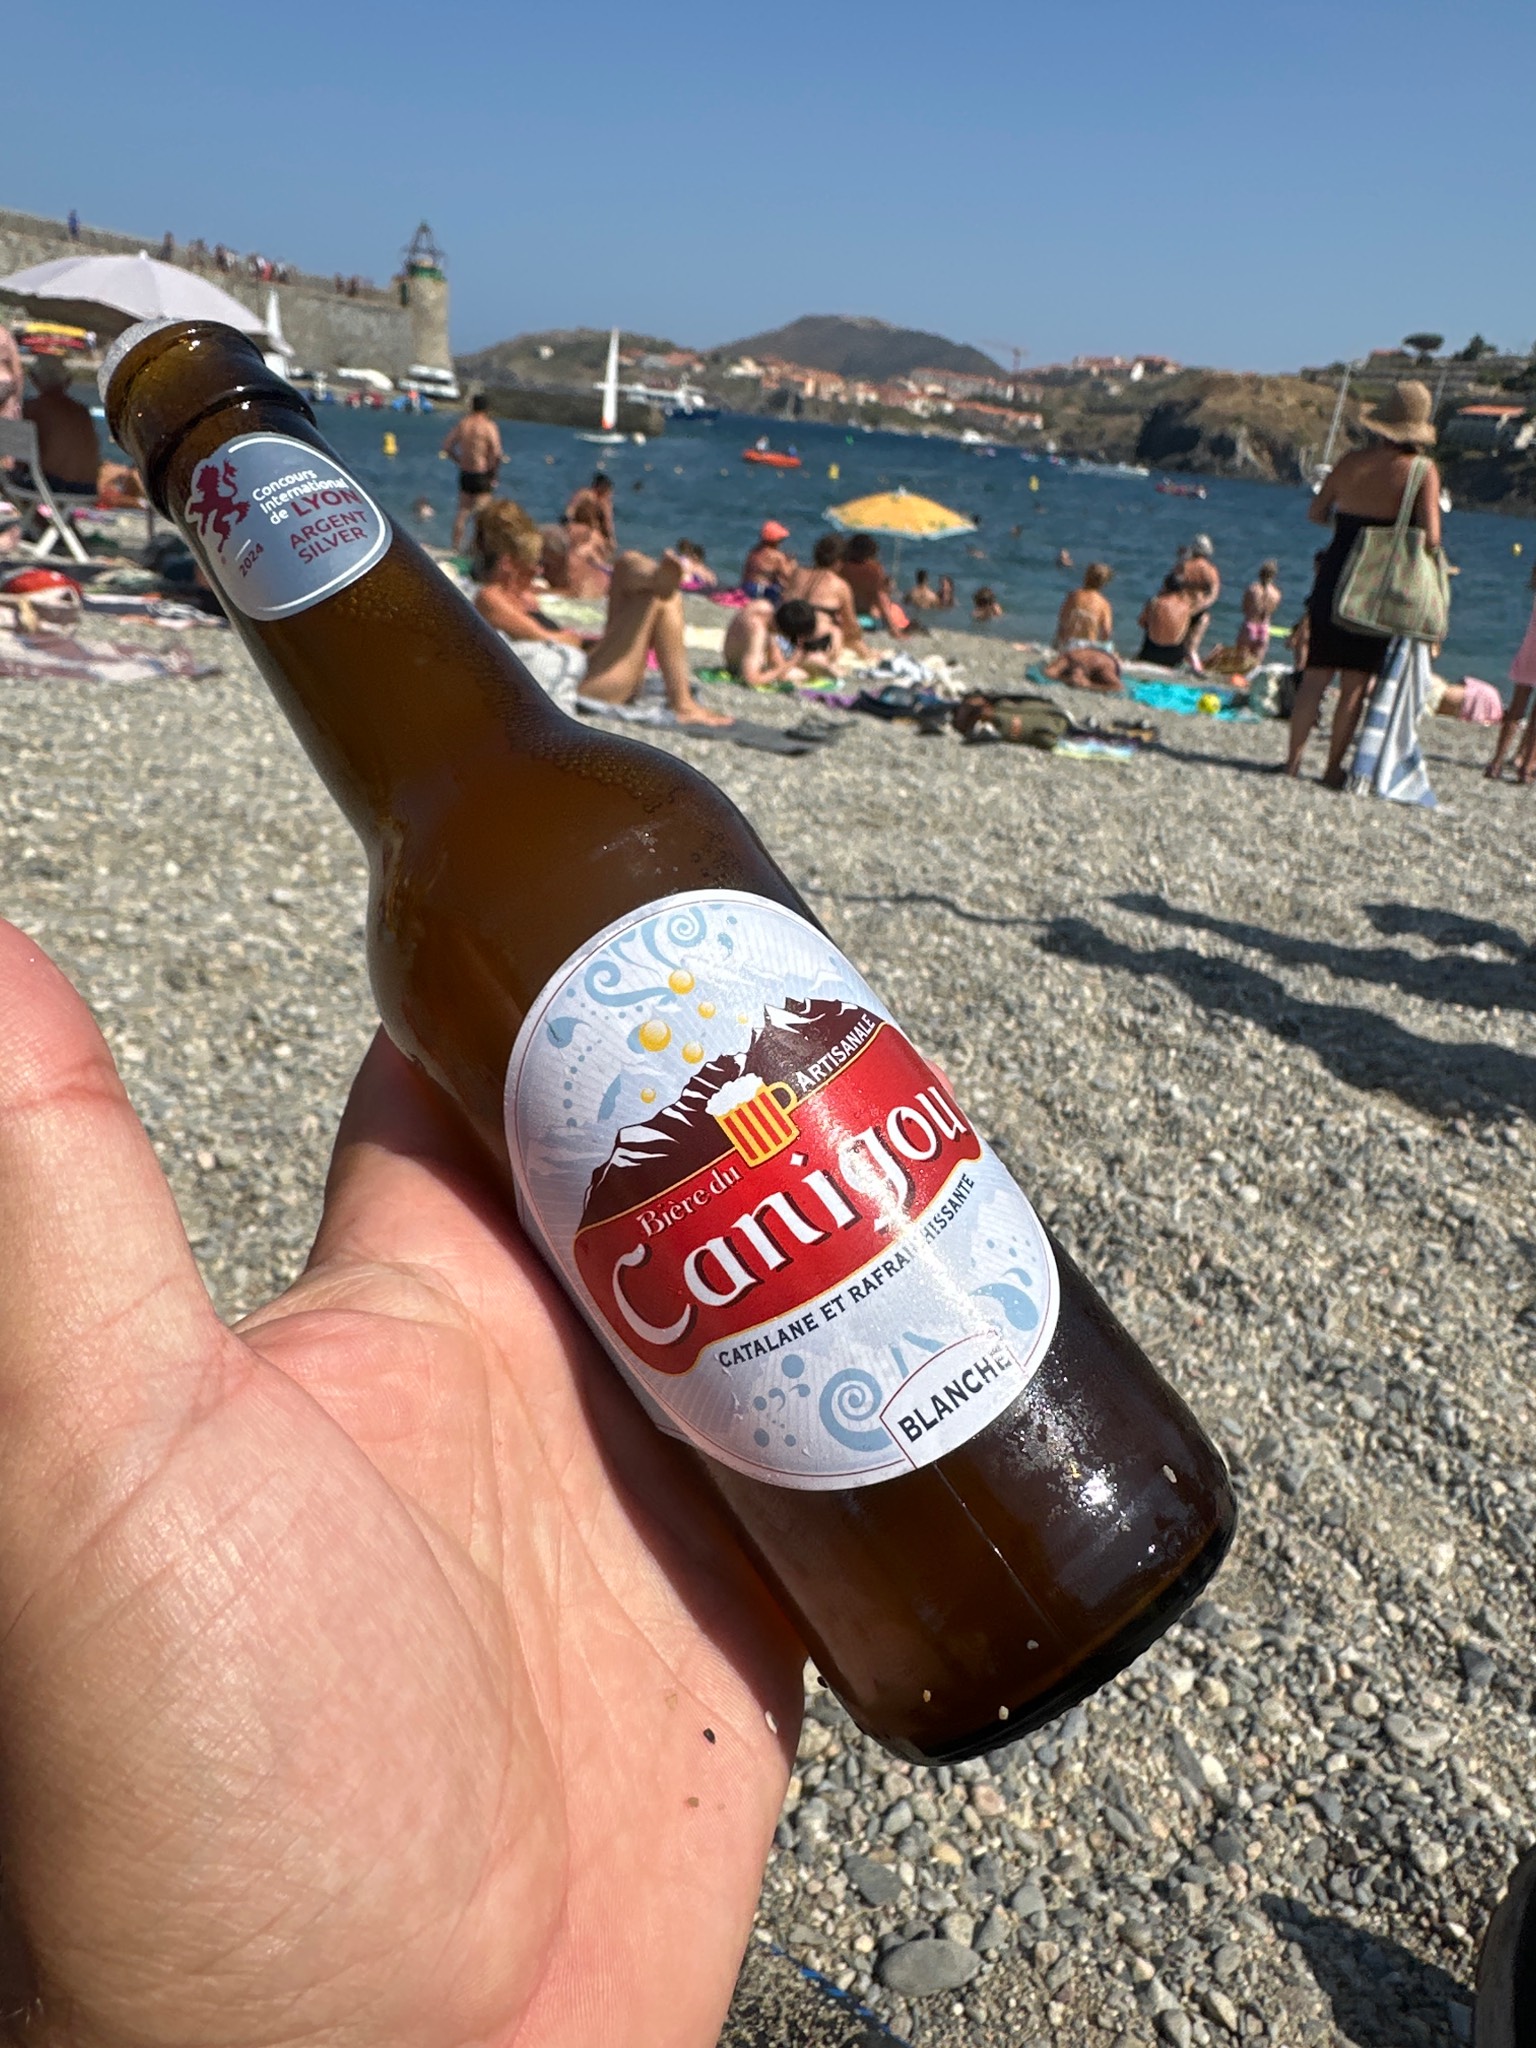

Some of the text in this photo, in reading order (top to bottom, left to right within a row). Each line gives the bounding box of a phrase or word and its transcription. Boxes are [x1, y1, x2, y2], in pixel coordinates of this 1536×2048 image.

[252, 469, 318, 502] Concours
[260, 478, 349, 514] International
[270, 490, 363, 525] de LYON
[290, 511, 368, 549] ARGENT
[298, 527, 368, 564] SILVER
[239, 543, 264, 577] 2024
[795, 1011, 876, 1092] ARTISANALE
[612, 1086, 970, 1347] Canigou
[635, 1163, 742, 1238] Bière du
[719, 1314, 818, 1367] CATALANE
[822, 1295, 847, 1322] ET
[897, 1345, 1013, 1443] BLANCHE
